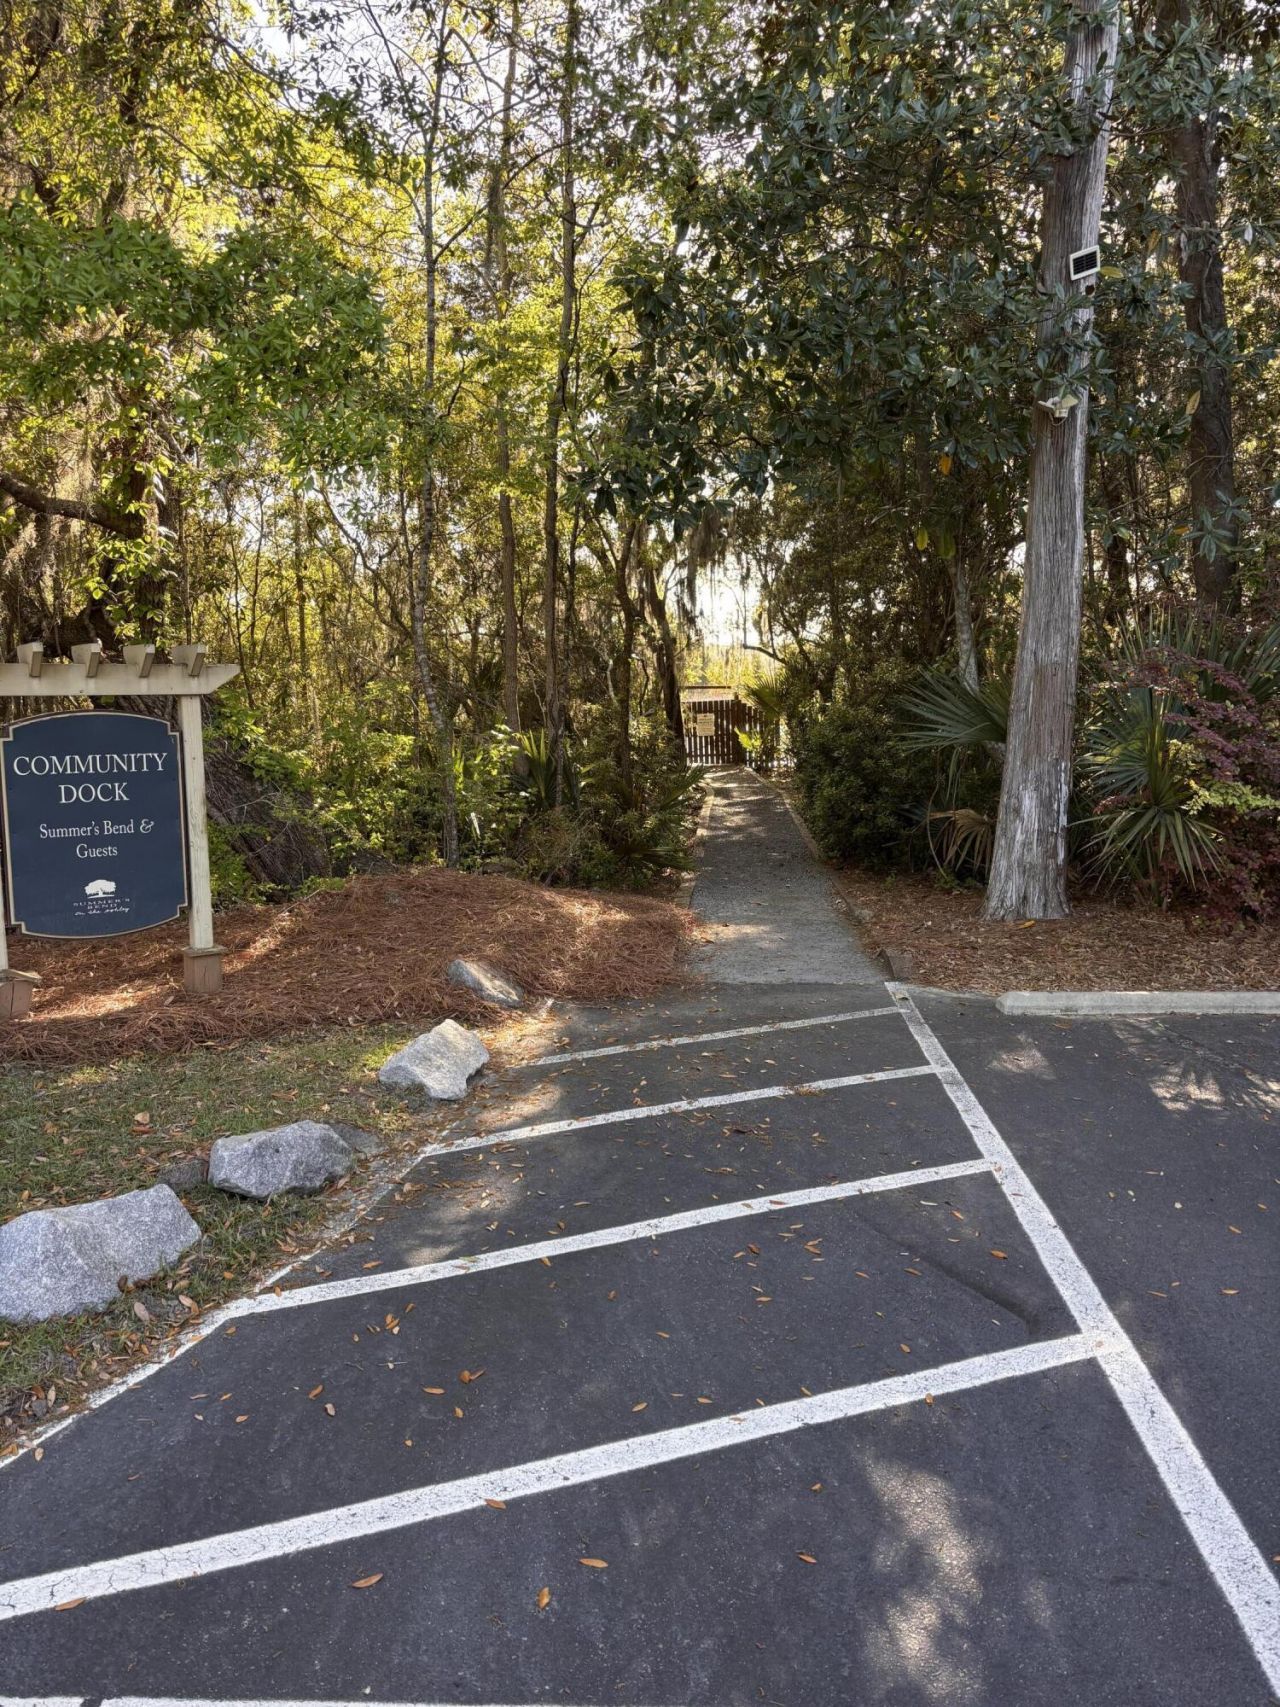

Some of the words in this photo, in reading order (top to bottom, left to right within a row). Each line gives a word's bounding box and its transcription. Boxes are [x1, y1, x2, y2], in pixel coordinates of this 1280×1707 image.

[13, 752, 168, 776] COMMUNITY
[58, 782, 130, 804] DOCK
[39, 821, 100, 839] Summer's
[103, 818, 135, 835] Bend
[139, 818, 155, 834] &
[76, 843, 118, 859] Guests
